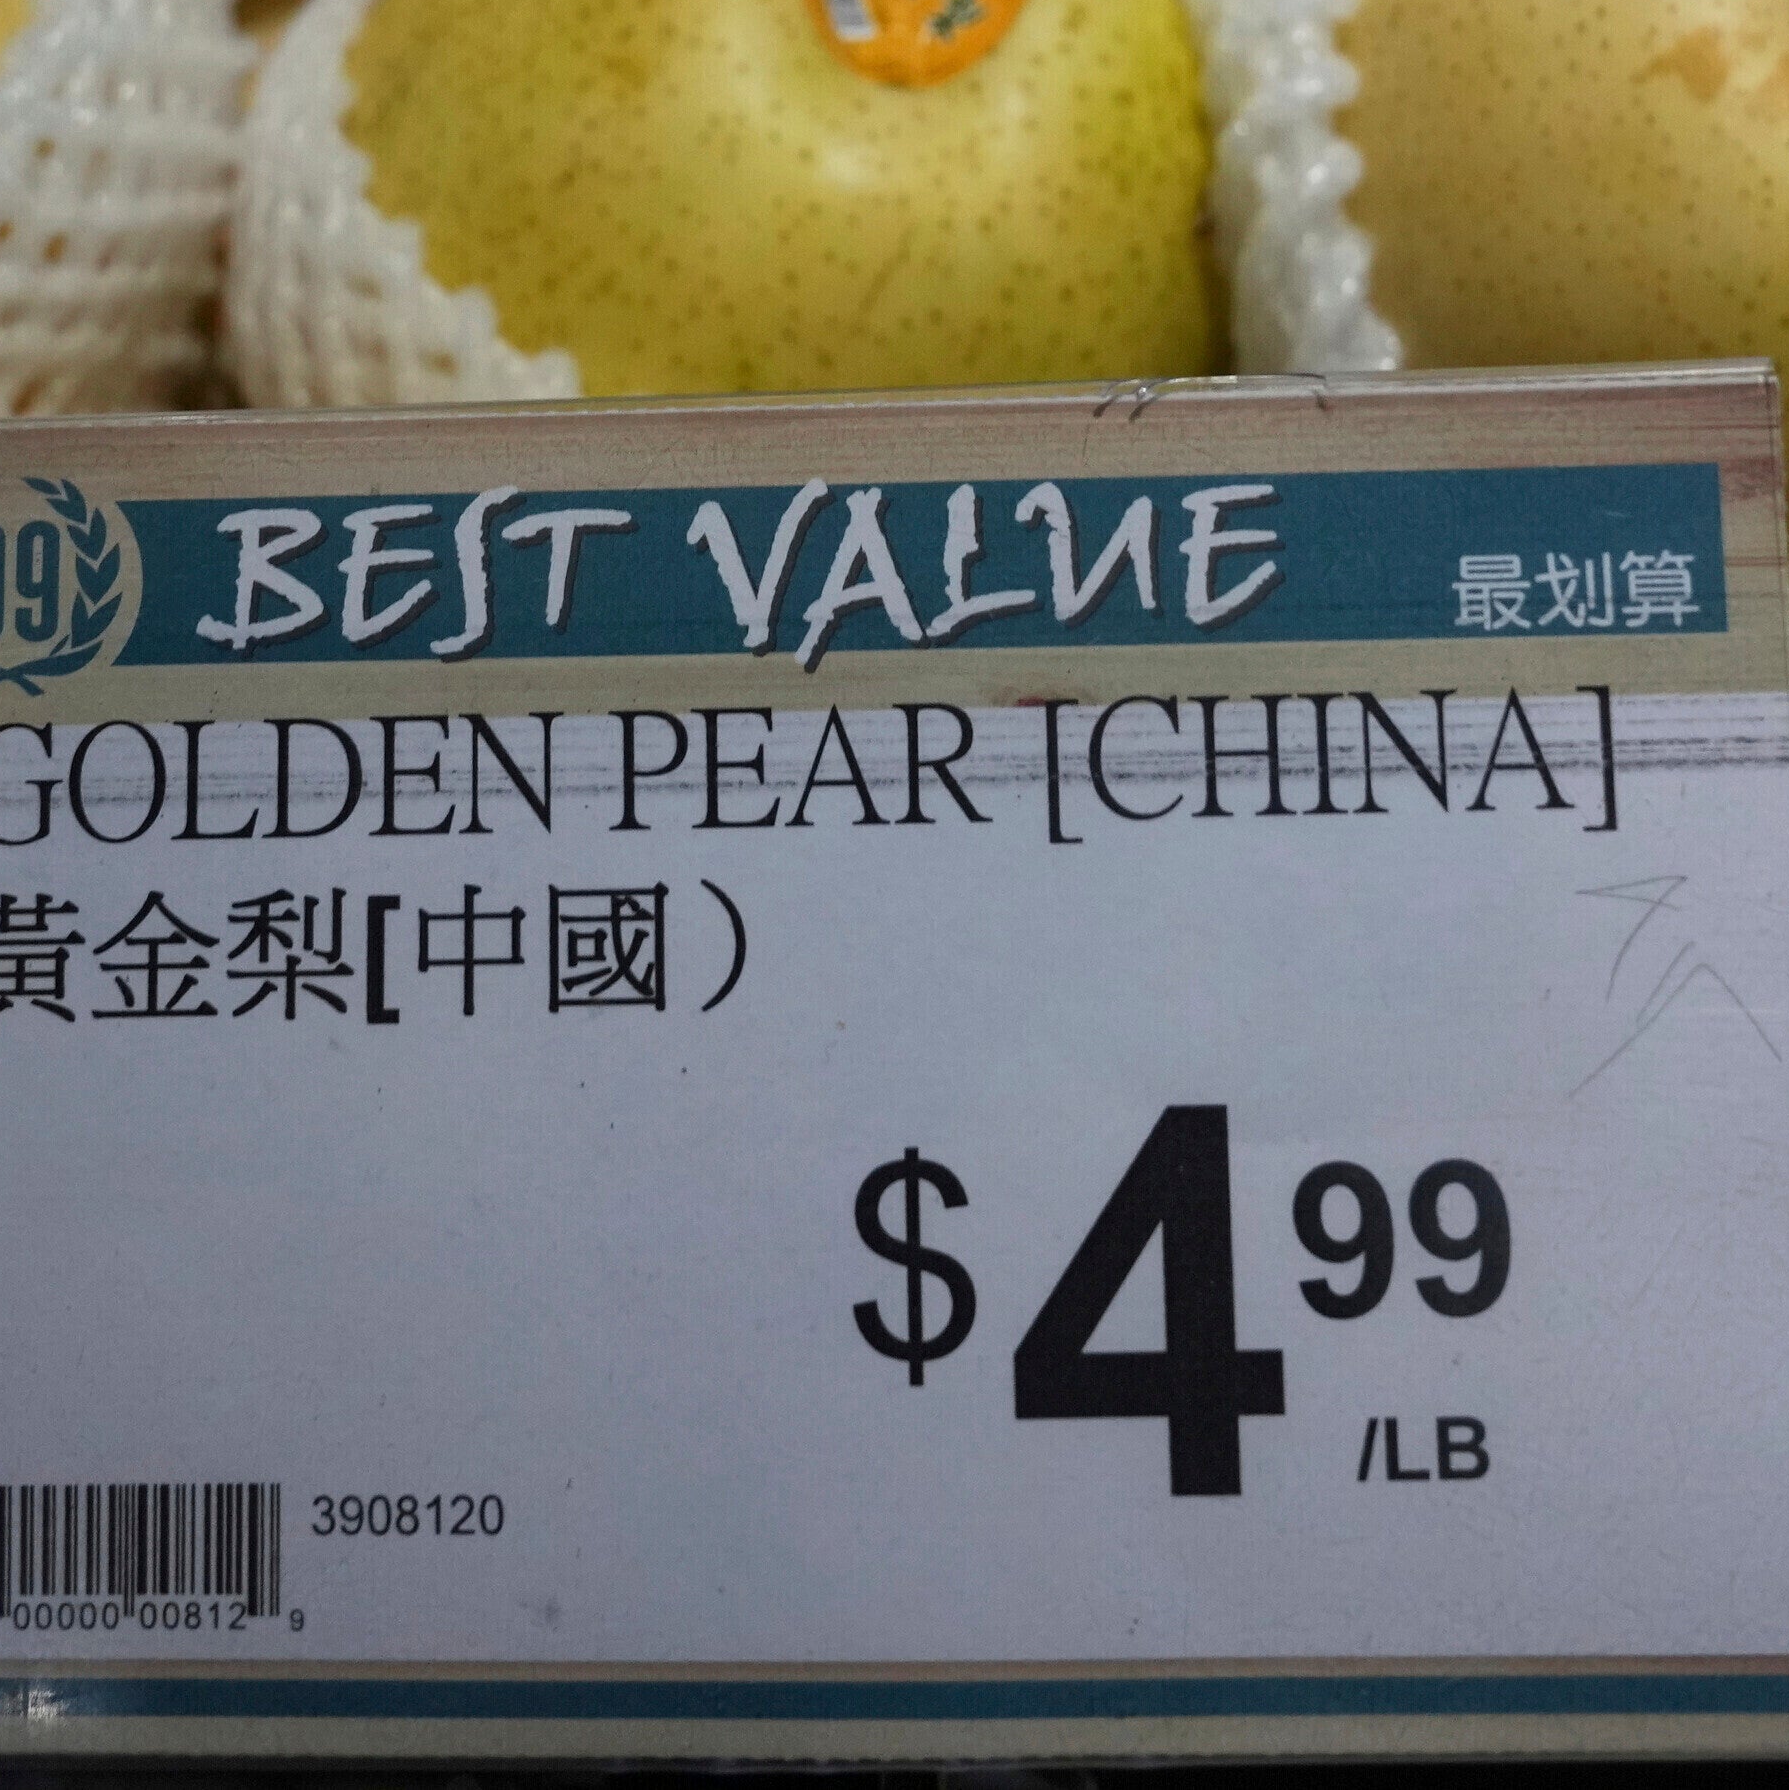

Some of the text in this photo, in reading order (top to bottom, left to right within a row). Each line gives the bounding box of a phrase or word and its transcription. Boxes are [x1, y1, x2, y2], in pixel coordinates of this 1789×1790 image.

[196, 478, 1280, 671] BEST VALUE
[1452, 549, 1700, 631] 最划算
[610, 701, 993, 833] PEAR
[1047, 684, 1619, 845] [CHINA]
[1357, 1416, 1491, 1482] /LB
[311, 1494, 505, 1537] 3908120
